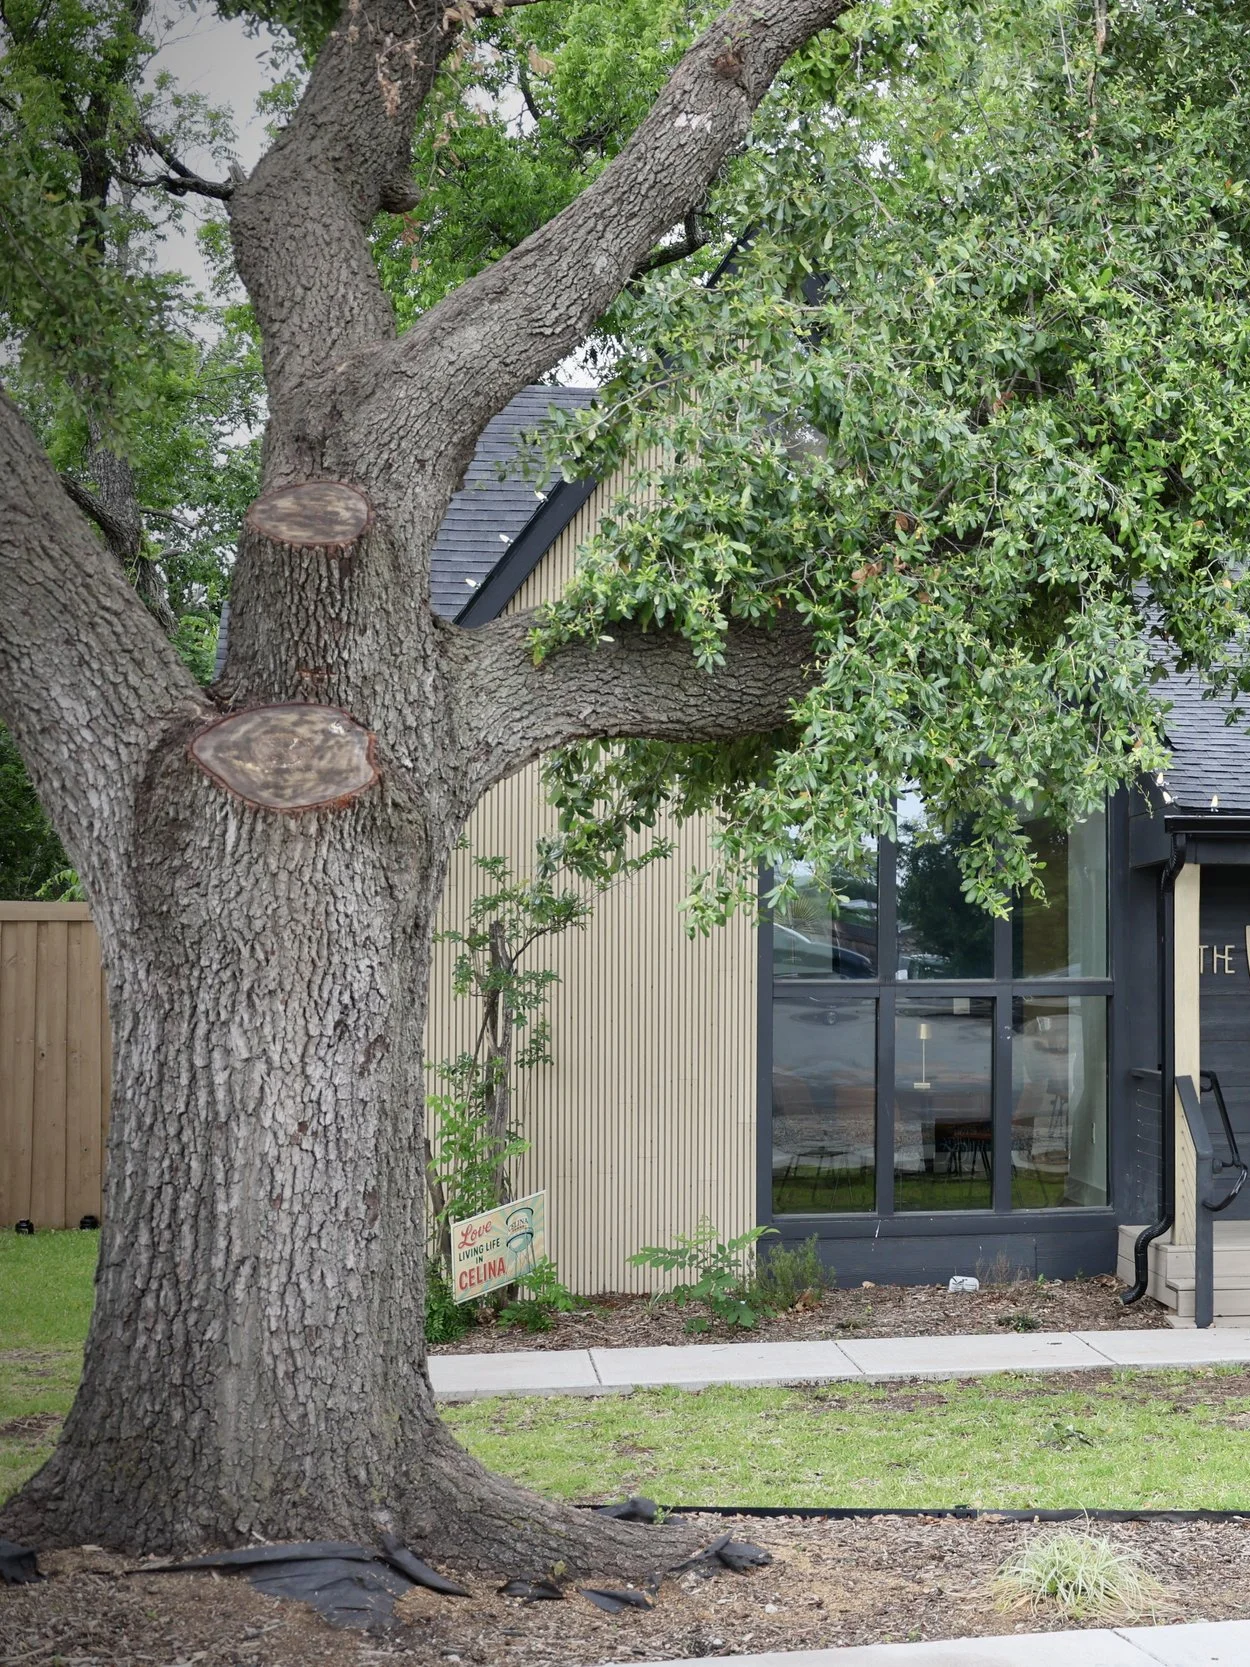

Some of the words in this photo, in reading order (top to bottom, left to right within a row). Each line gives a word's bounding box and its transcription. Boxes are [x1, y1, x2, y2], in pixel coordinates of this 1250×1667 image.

[1199, 945, 1235, 974] THE
[458, 1220, 492, 1249] Love
[458, 1244, 484, 1261] LIVING
[485, 1237, 501, 1252] LIFE
[458, 1257, 506, 1291] CELINA
[475, 1255, 484, 1264] IN
